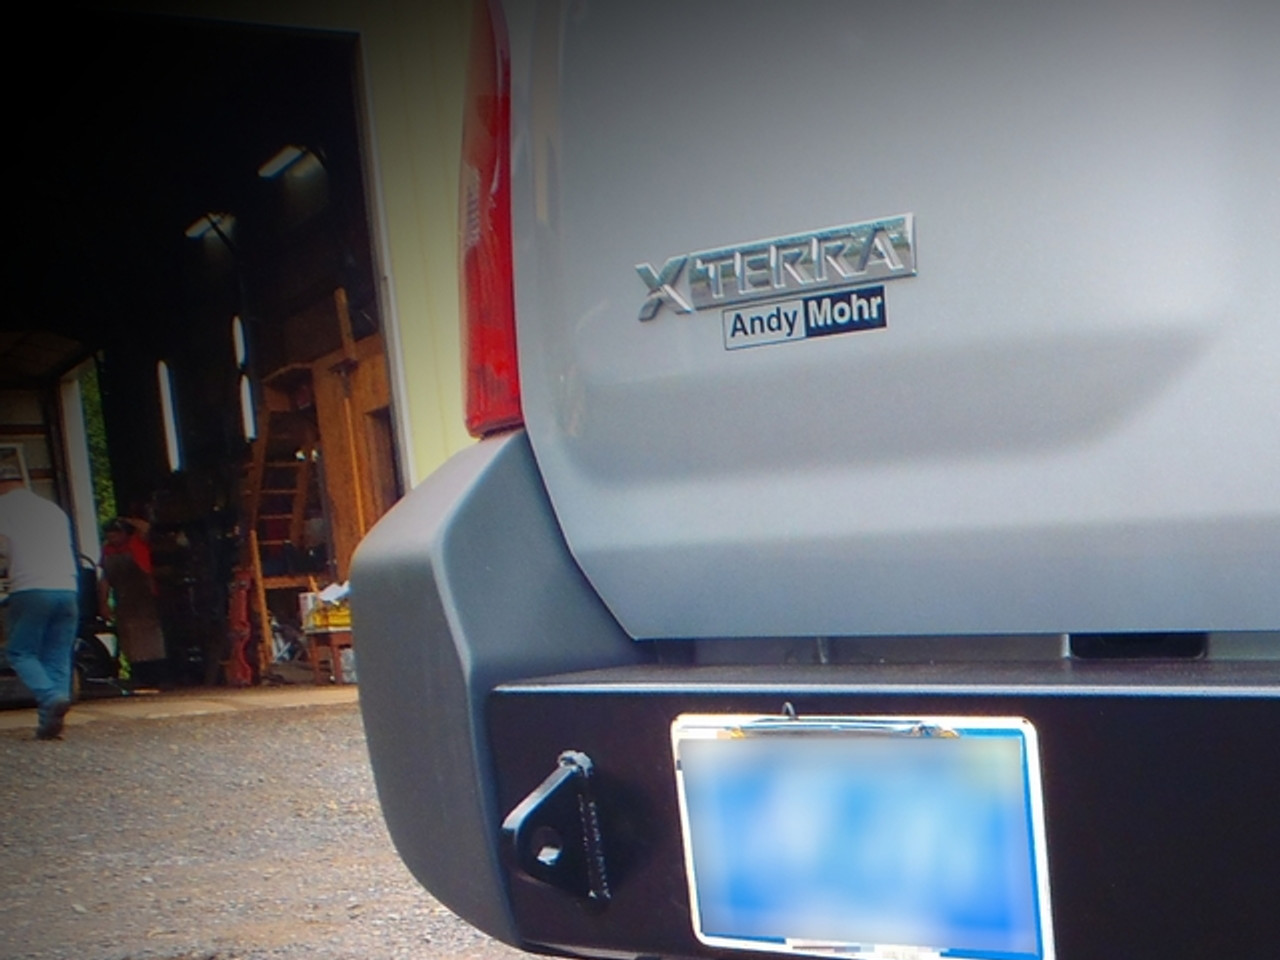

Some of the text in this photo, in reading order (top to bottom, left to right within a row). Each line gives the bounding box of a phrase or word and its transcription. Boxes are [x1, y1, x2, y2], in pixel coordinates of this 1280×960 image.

[635, 213, 917, 321] XTERRA
[729, 293, 883, 338] Andy Mohr
